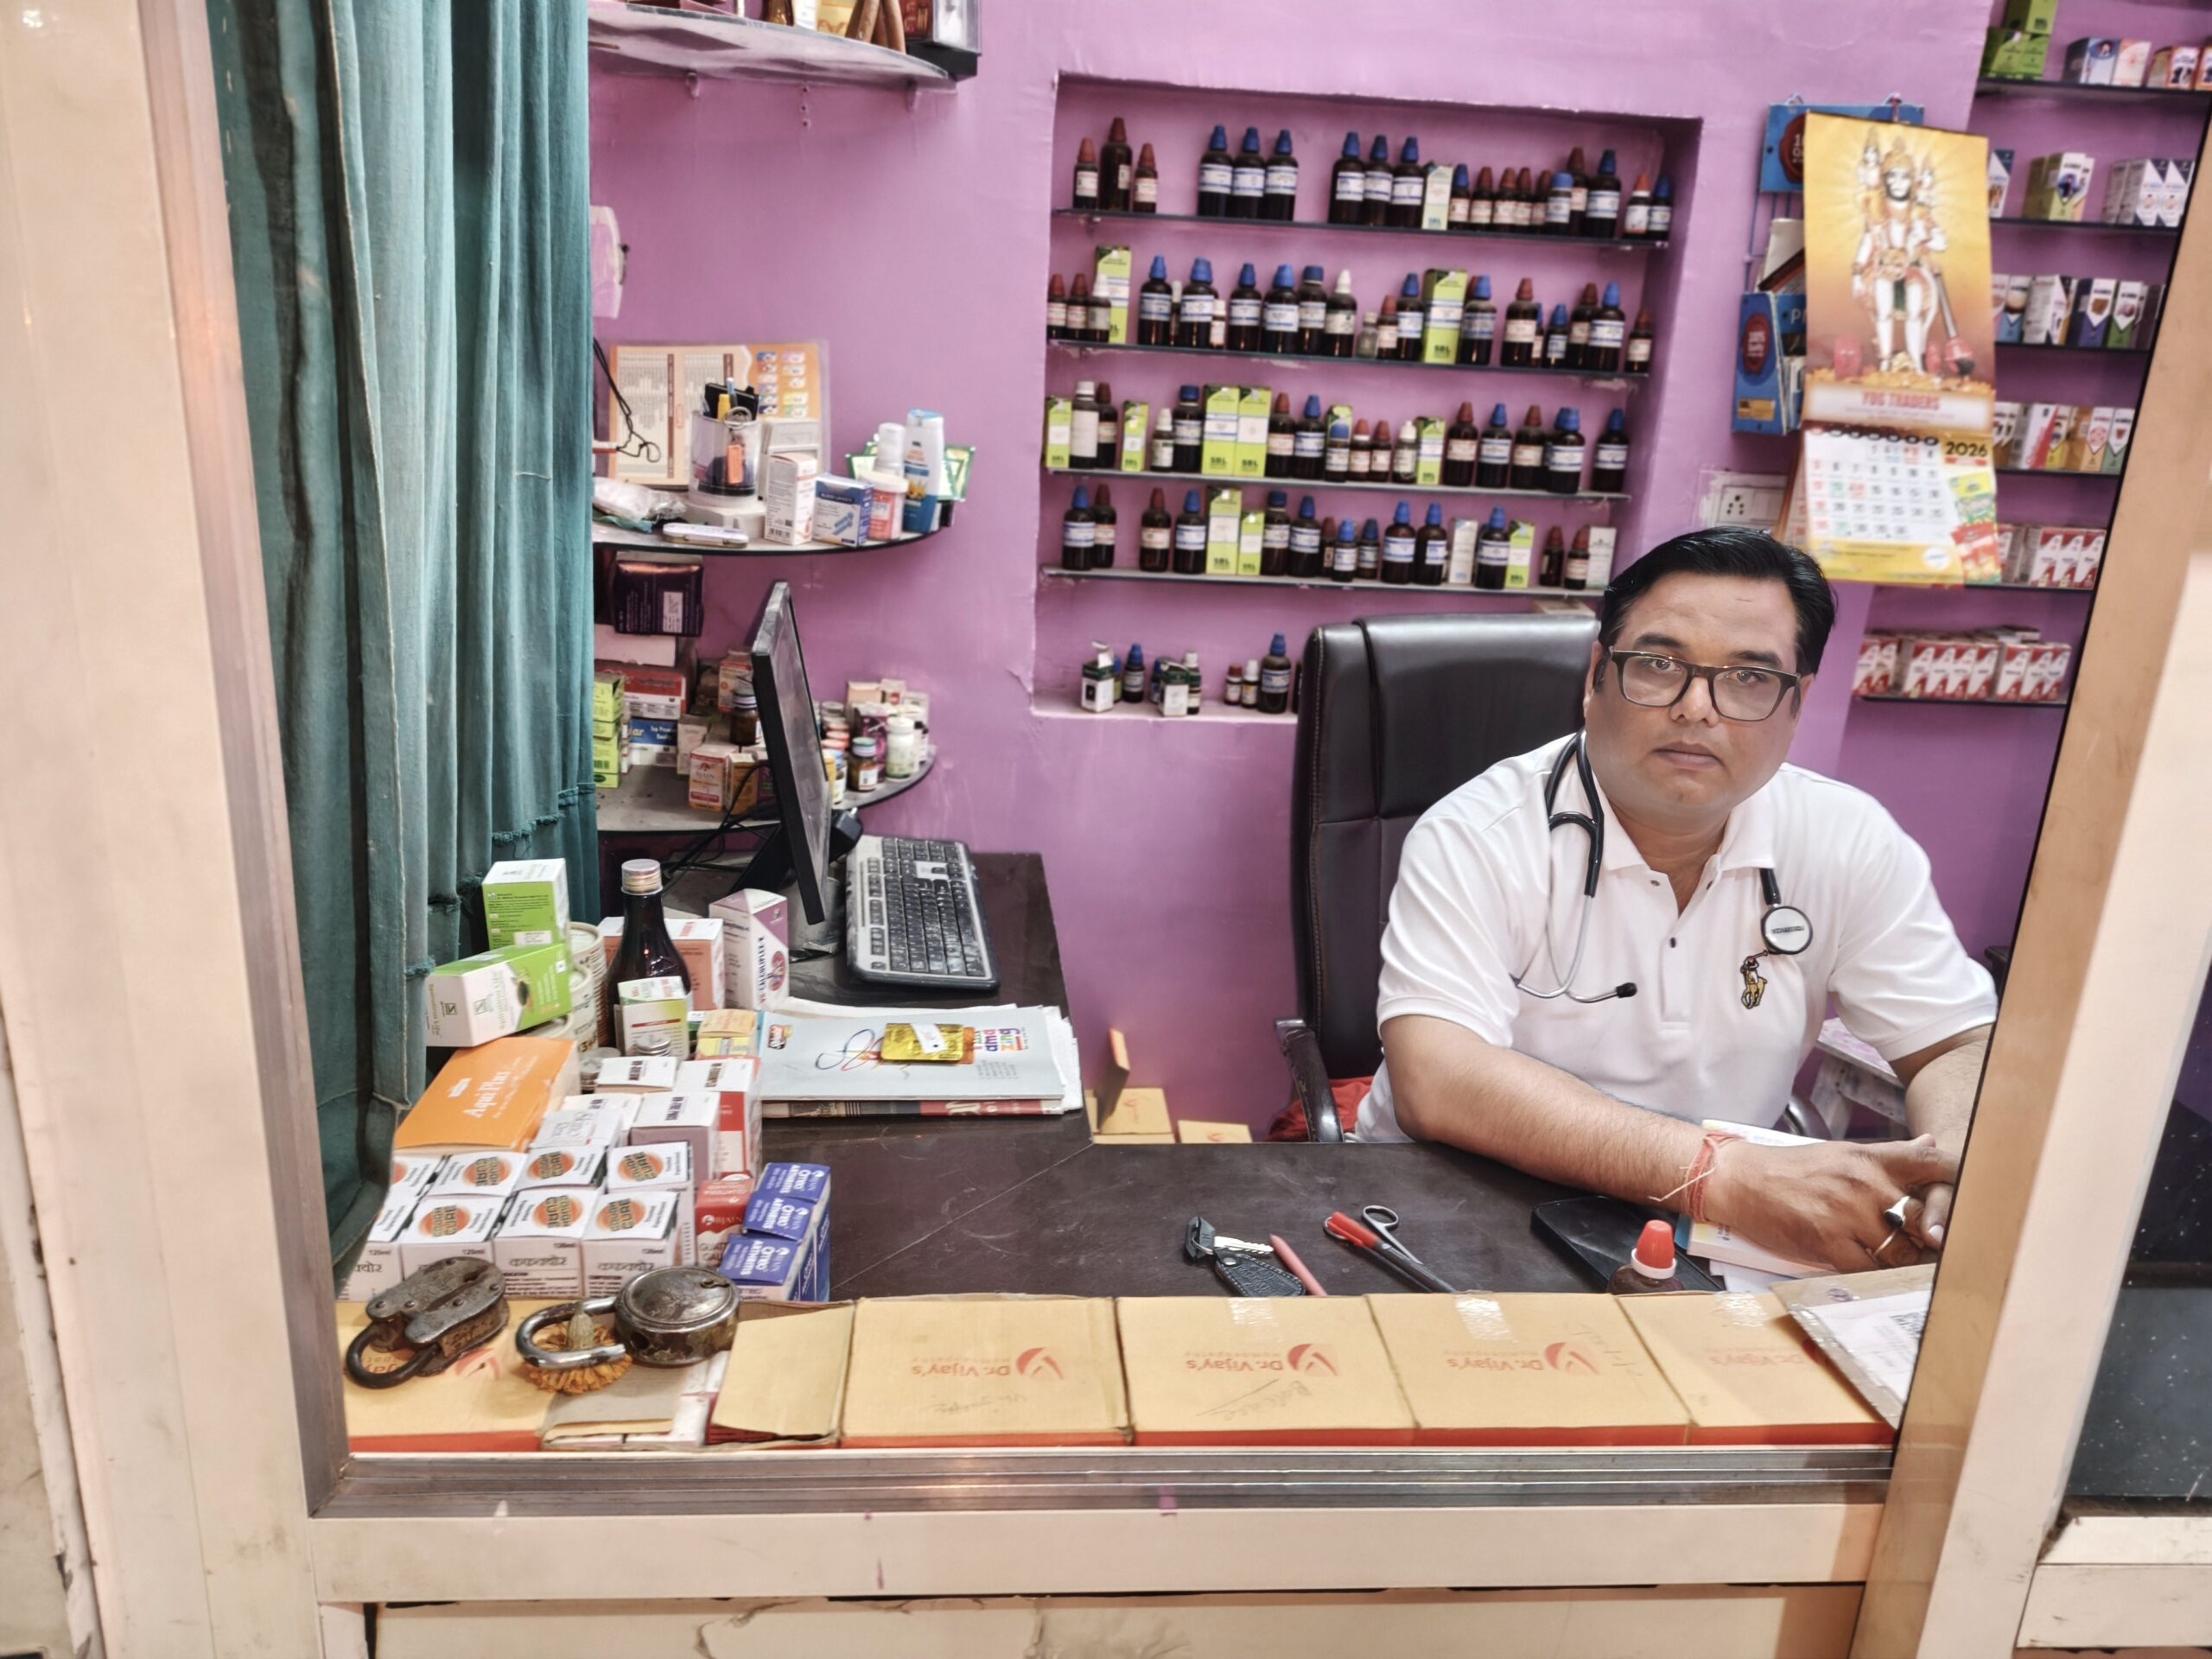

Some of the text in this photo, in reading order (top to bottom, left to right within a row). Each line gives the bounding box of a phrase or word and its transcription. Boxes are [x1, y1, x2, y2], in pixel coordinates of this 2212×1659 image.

[1946, 442, 1988, 457] 2026
[912, 1363, 1010, 1377] Dr. Vijay's
[1186, 1358, 1284, 1372] Dr. Vijay's
[1446, 1357, 1544, 1371] Dr. Vijay's
